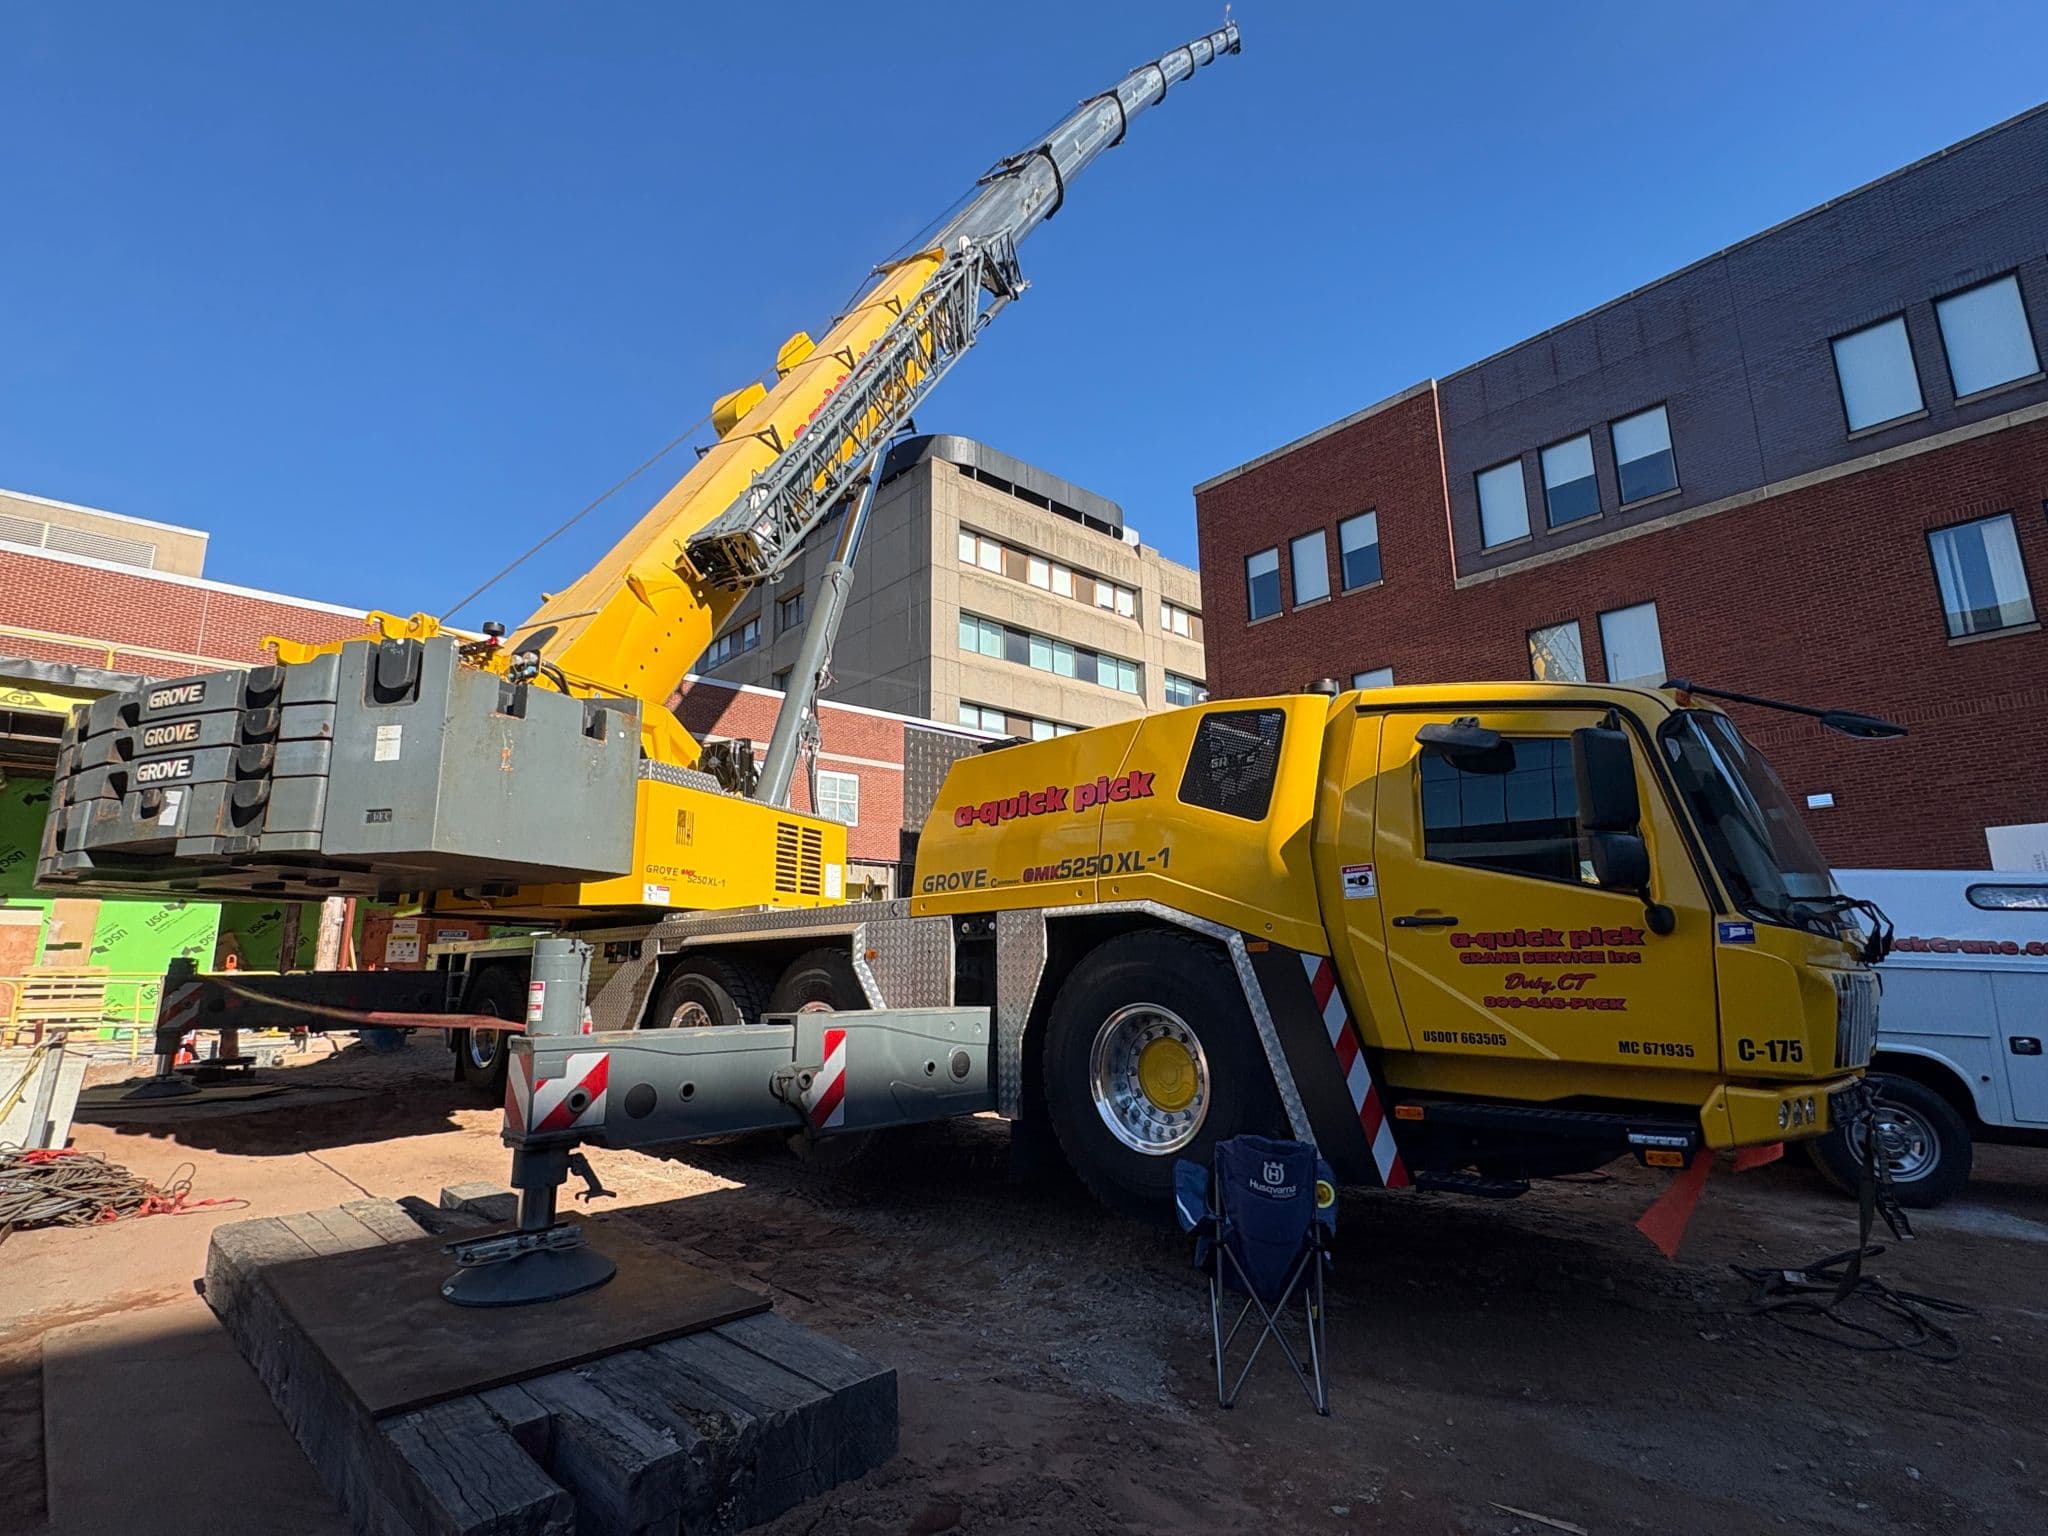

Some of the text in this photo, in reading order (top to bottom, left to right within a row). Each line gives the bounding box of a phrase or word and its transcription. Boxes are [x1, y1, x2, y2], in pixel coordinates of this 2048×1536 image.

[6, 693, 35, 704] GP
[149, 684, 203, 708] GROVE
[144, 722, 199, 747] GROVE
[136, 758, 192, 782] GROVE
[954, 770, 1155, 827] a-quick pick
[646, 864, 679, 877] GROVE
[923, 869, 988, 892] GROVE
[145, 910, 169, 928] USG
[103, 928, 129, 946] USG
[1450, 927, 1646, 950] a-quick pick
[1459, 951, 1521, 964] CRANE
[1523, 951, 1606, 964] SERVICE
[1423, 1030, 1507, 1046] USDOT 663505
[1618, 1040, 1695, 1058] MC 671935
[1738, 1038, 1804, 1063] C-175
[1249, 1177, 1297, 1195] Husqvarna
